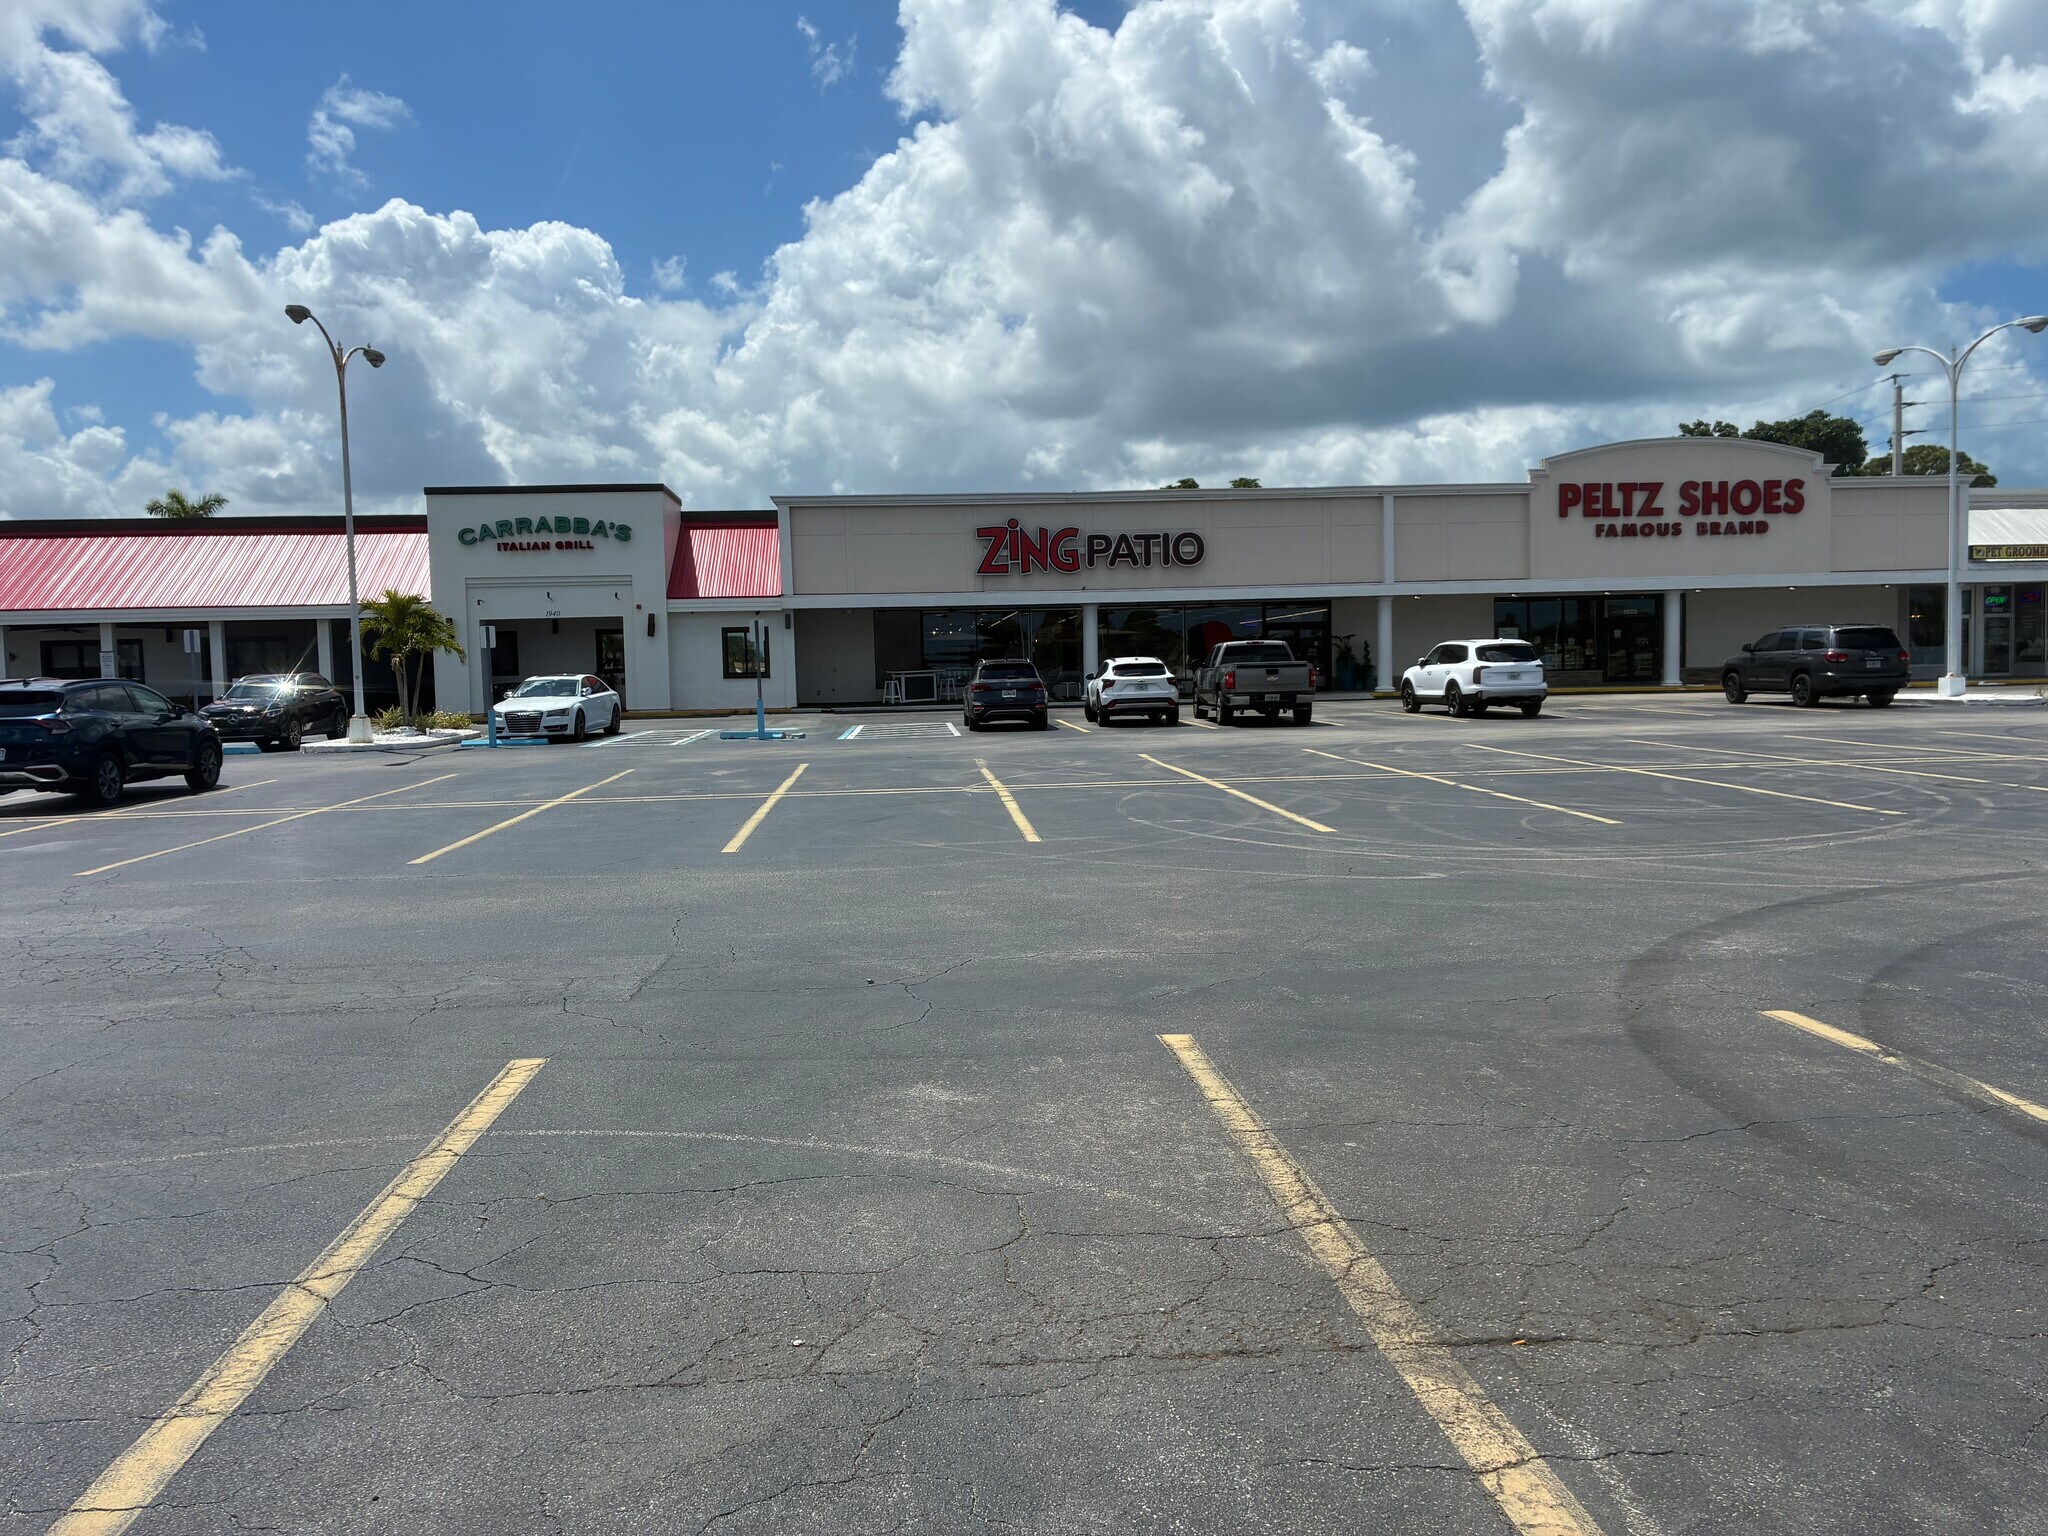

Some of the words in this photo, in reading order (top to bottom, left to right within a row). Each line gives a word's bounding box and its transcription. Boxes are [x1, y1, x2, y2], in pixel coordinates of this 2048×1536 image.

[1559, 482, 1665, 517] PELTZ
[1679, 479, 1805, 516] SHOES
[458, 516, 632, 545] CARRABBA'S
[1595, 522, 1682, 537] FAMOUS
[1696, 520, 1769, 536] BRAND
[497, 541, 551, 551] ITALIAN
[555, 540, 594, 550] GRILL
[1085, 531, 1206, 568] PATIO
[1986, 547, 2002, 557] PET
[1986, 596, 2006, 604] OPEN
